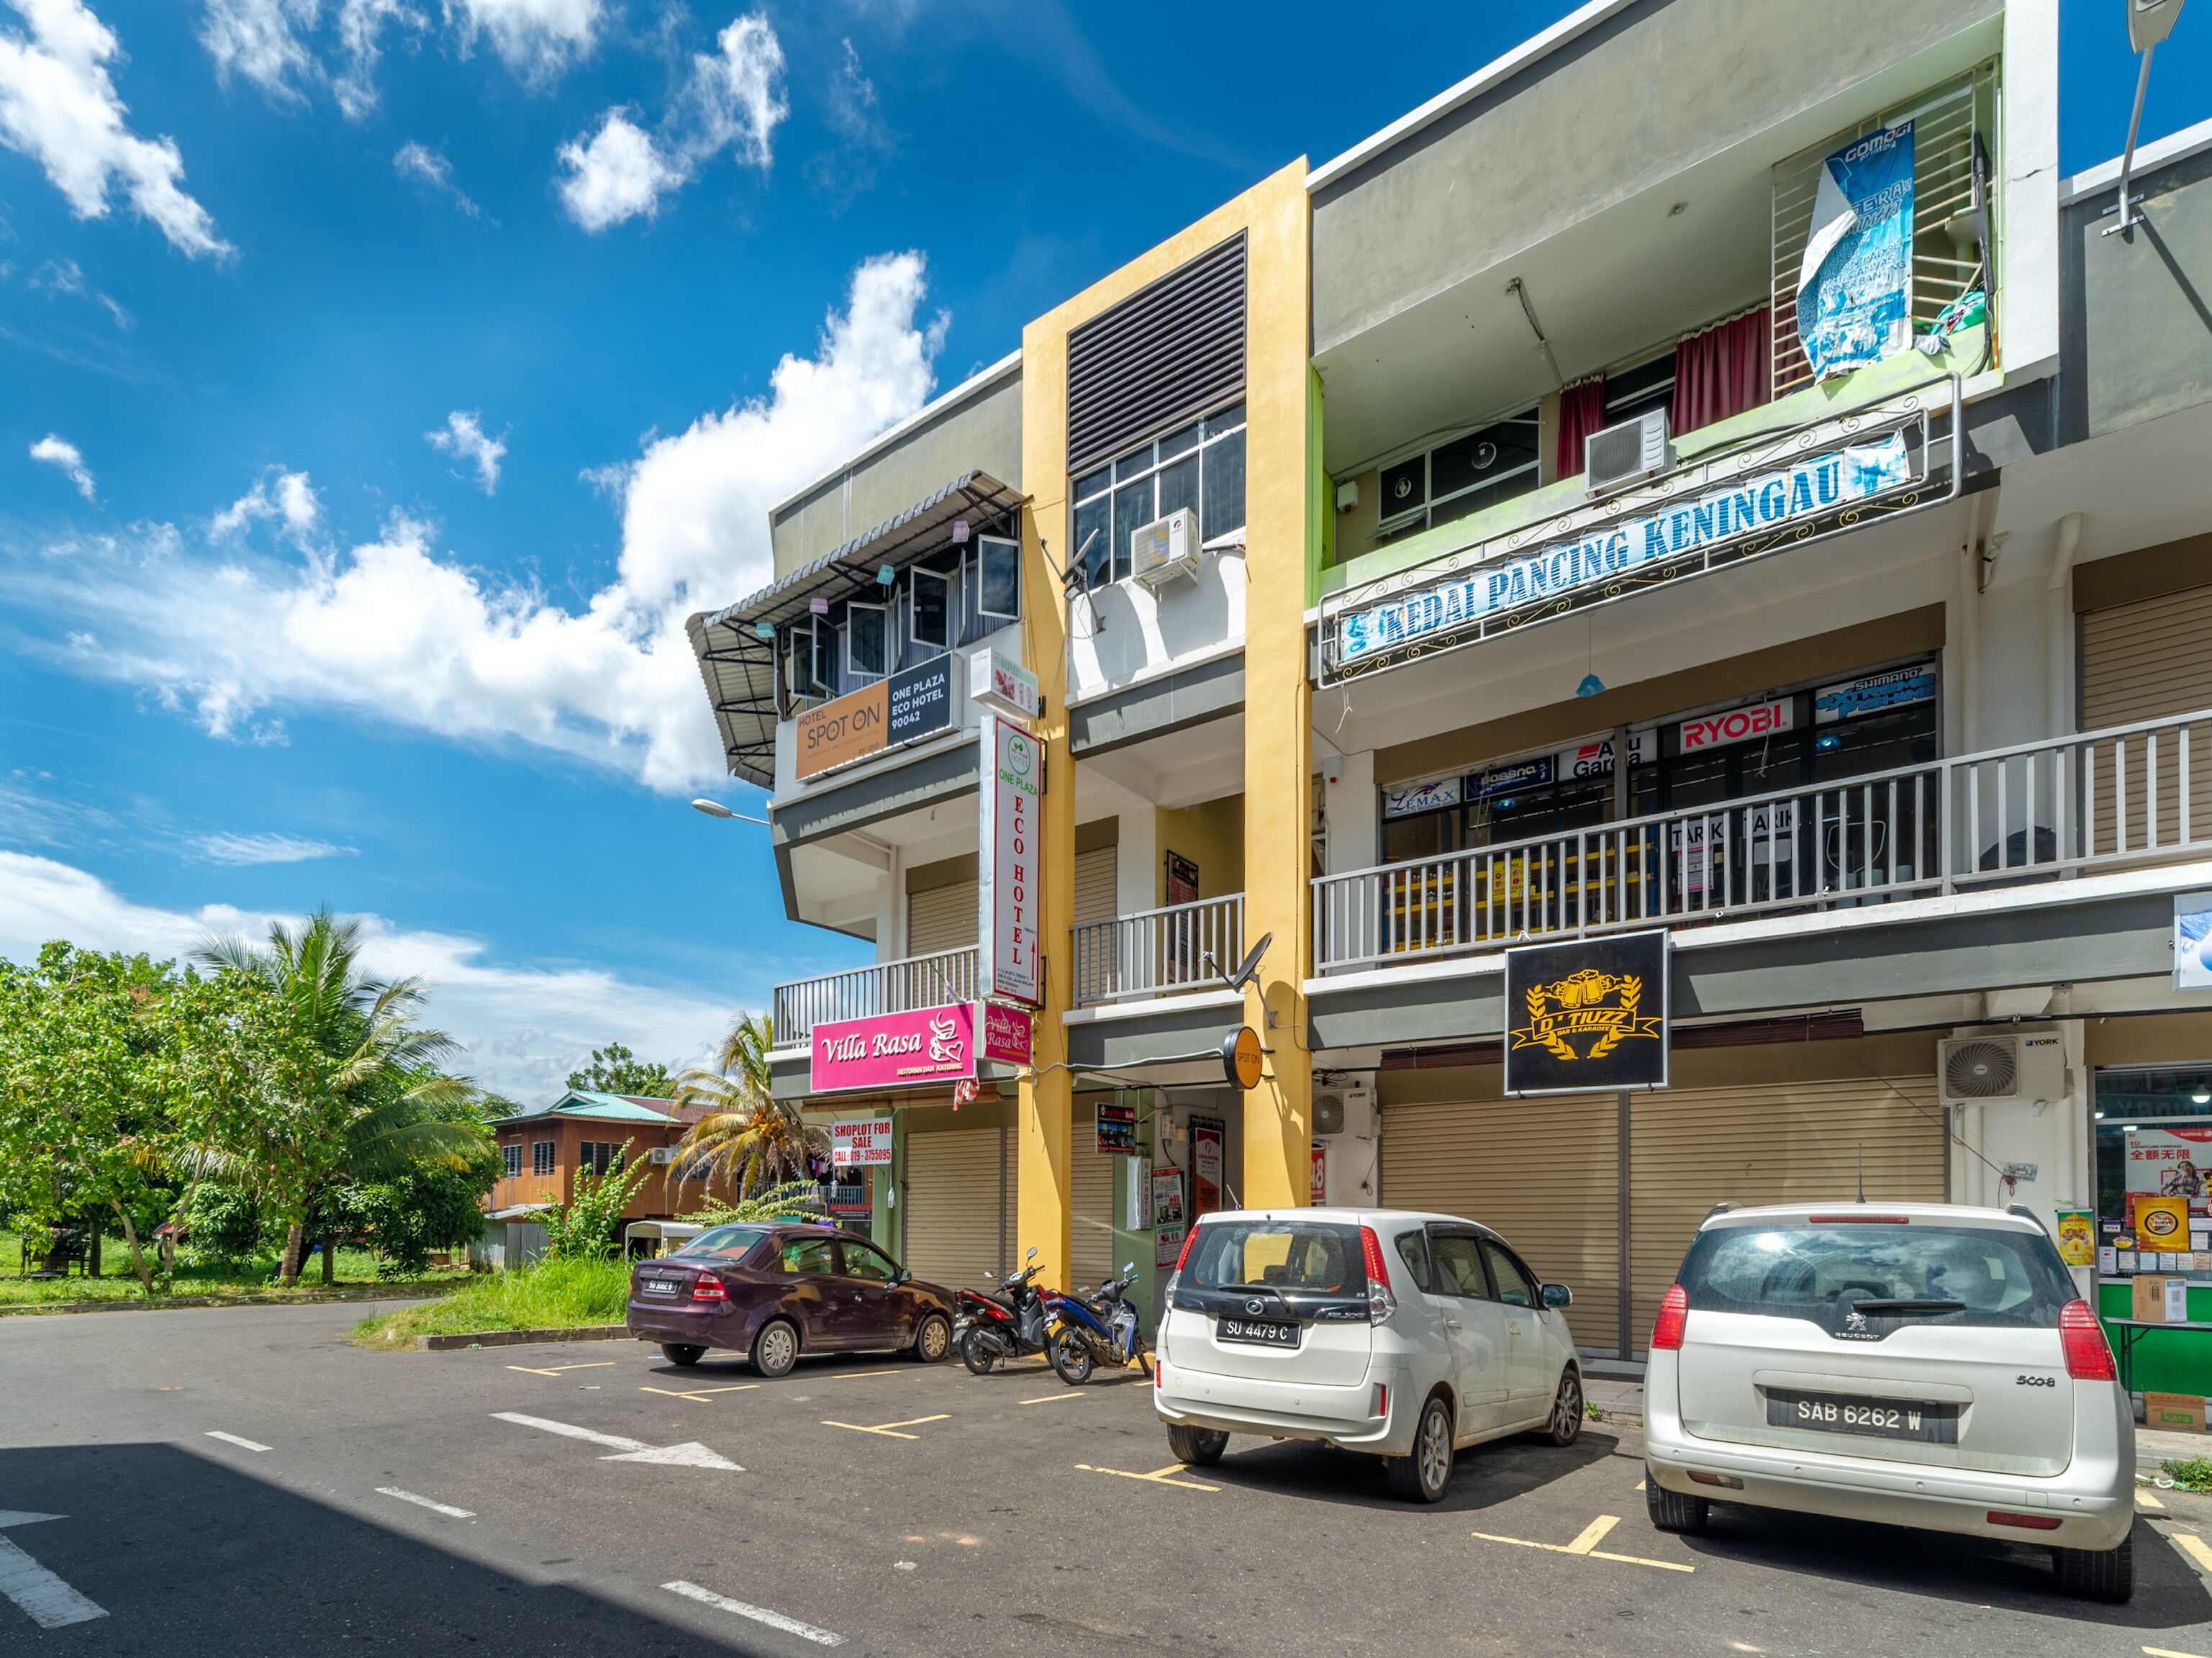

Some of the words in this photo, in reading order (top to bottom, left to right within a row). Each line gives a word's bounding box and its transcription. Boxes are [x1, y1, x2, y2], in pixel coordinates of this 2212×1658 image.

[1387, 582, 1475, 643] KEDAI
[1488, 531, 1628, 610] PANCING
[1644, 461, 1840, 560] KENINGAU
[892, 687, 911, 702] ONE
[913, 674, 945, 694] PLAZA
[1855, 669, 1919, 691] SHIMANO
[892, 701, 910, 717] ECO
[912, 689, 943, 708] HOTEL
[799, 710, 827, 728] HOTEL
[807, 715, 848, 749] SPOT
[853, 702, 880, 731] ON
[892, 711, 920, 730] 90042
[1683, 705, 1781, 748] RYOBI
[999, 769, 1014, 785] ONE
[1016, 777, 1038, 798] PLAZA
[1014, 795, 1024, 855] ECO
[1012, 864, 1024, 965] HOTEL
[987, 1015, 1012, 1035] Villa
[821, 1034, 867, 1063] Villa
[872, 1033, 923, 1057] Rasa
[987, 1032, 1012, 1048] Rasa
[1237, 1051, 1251, 1063] SPOT
[1251, 1054, 1260, 1064] ON
[897, 1066, 923, 1076] RESTORAN
[936, 1062, 964, 1072] KATERING
[835, 1123, 872, 1137] SHOPLOT
[874, 1123, 891, 1135] FOR
[852, 1136, 871, 1149] SALE
[835, 1151, 846, 1162] CALL
[851, 1150, 861, 1161] 019
[865, 1149, 891, 1161] 3755095
[2131, 1149, 2191, 1160] 全额无限
[648, 1280, 656, 1289] SU
[1227, 1321, 1242, 1335] SU
[1246, 1323, 1276, 1338] 4479
[1279, 1326, 1288, 1340] C
[2016, 1375, 2055, 1387] 5008
[1798, 1400, 1837, 1421] SAB
[1844, 1405, 1900, 1428] 6262
[1908, 1410, 1921, 1431] W
[2164, 1413, 2189, 1423] kara
